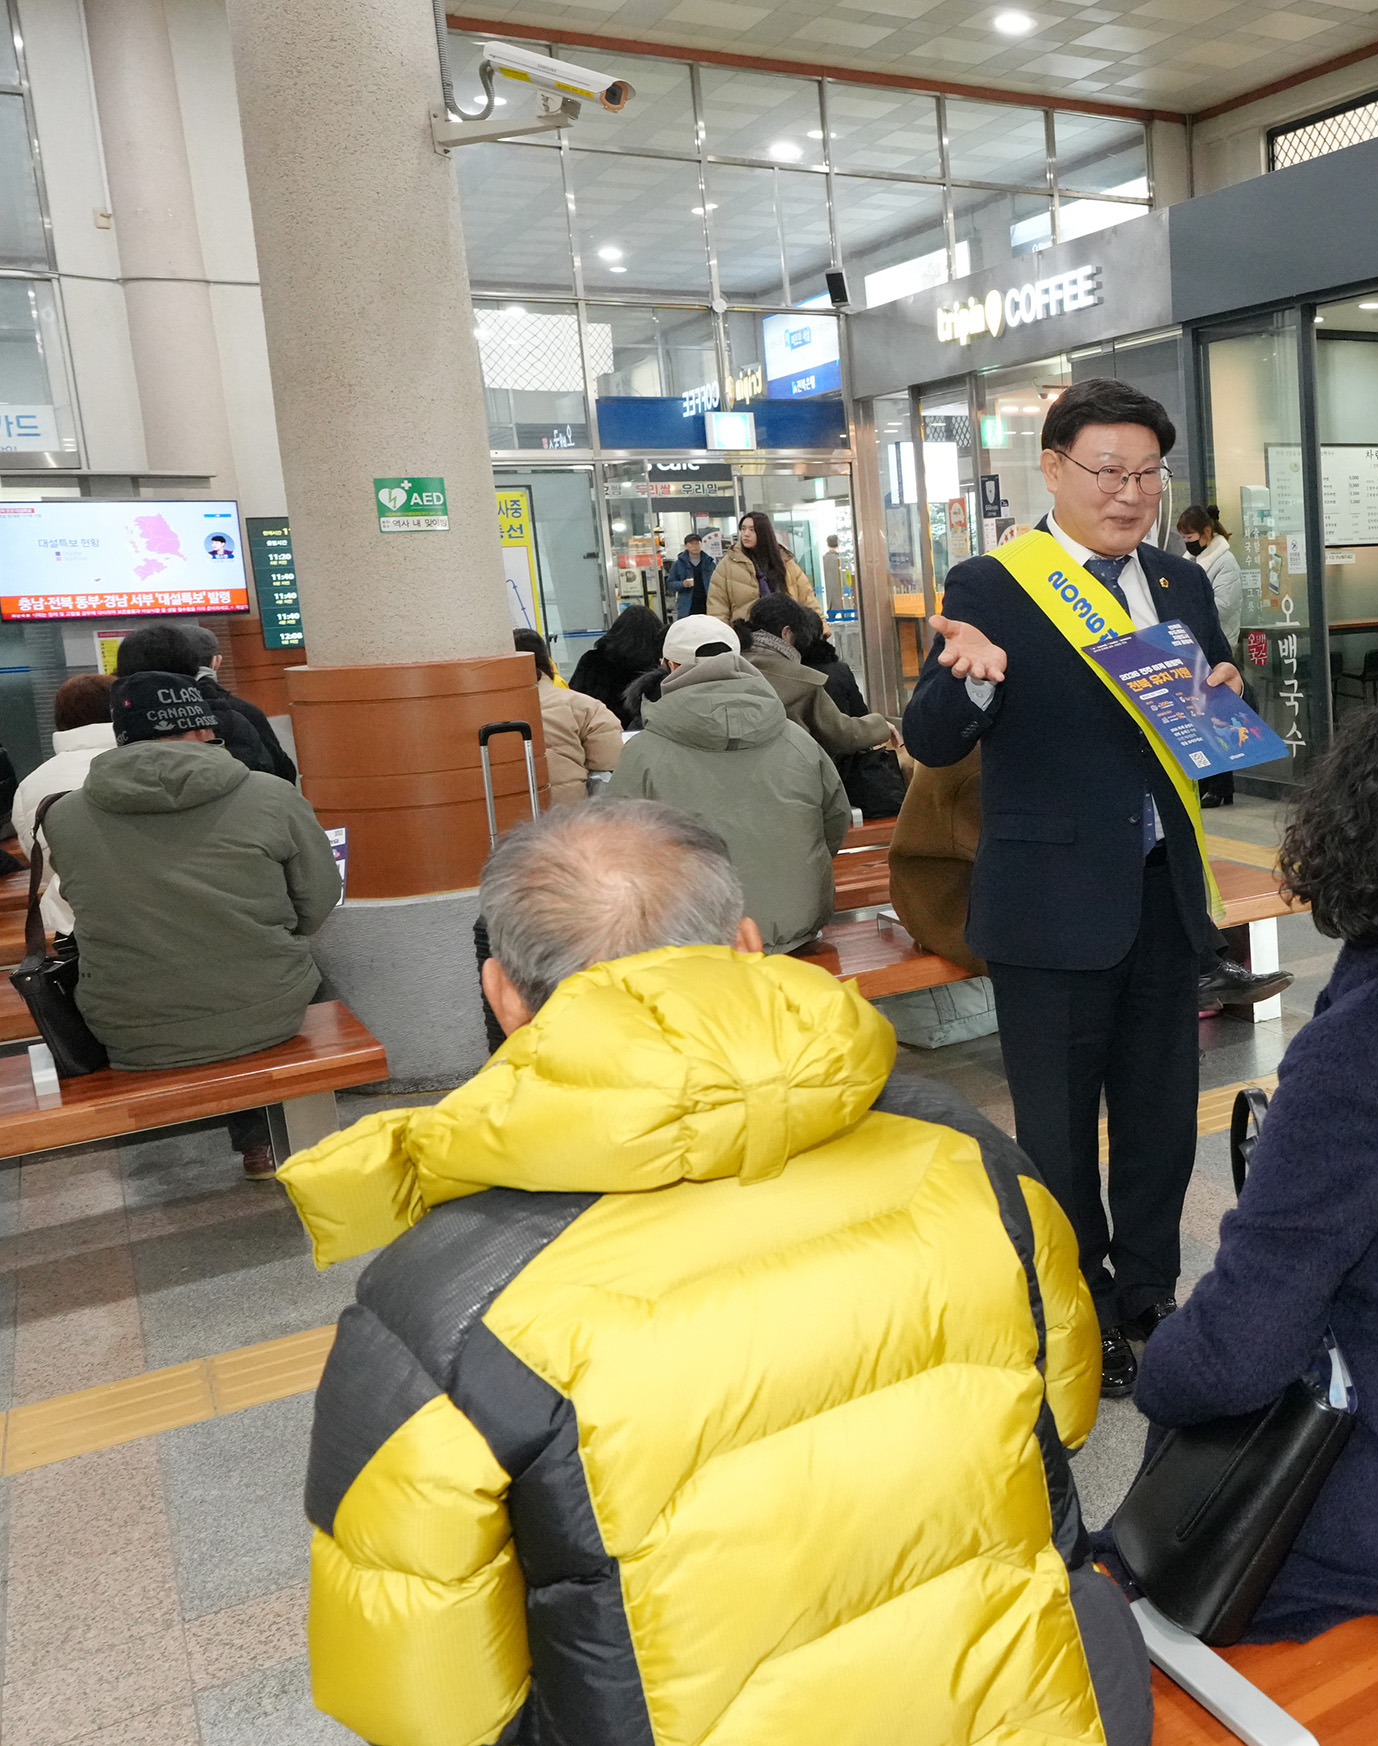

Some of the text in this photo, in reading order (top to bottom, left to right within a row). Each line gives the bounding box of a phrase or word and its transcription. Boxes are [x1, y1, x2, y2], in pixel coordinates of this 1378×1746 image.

[1004, 264, 1096, 328] COFFEE
[682, 483, 718, 495] 우리밀
[410, 492, 445, 506] AED
[393, 519, 410, 528] 역사
[413, 519, 422, 528] 내
[38, 538, 101, 548] 대설특보 현황
[18, 595, 74, 611] 충남·전북
[75, 593, 129, 610] 동부·경남
[130, 592, 155, 607] 서부
[207, 590, 231, 604] 발령
[1048, 571, 1105, 634] 2036
[1126, 667, 1193, 692] 전북 유치 기원
[1275, 594, 1307, 758] 오백국수
[146, 705, 204, 721] CANADA
